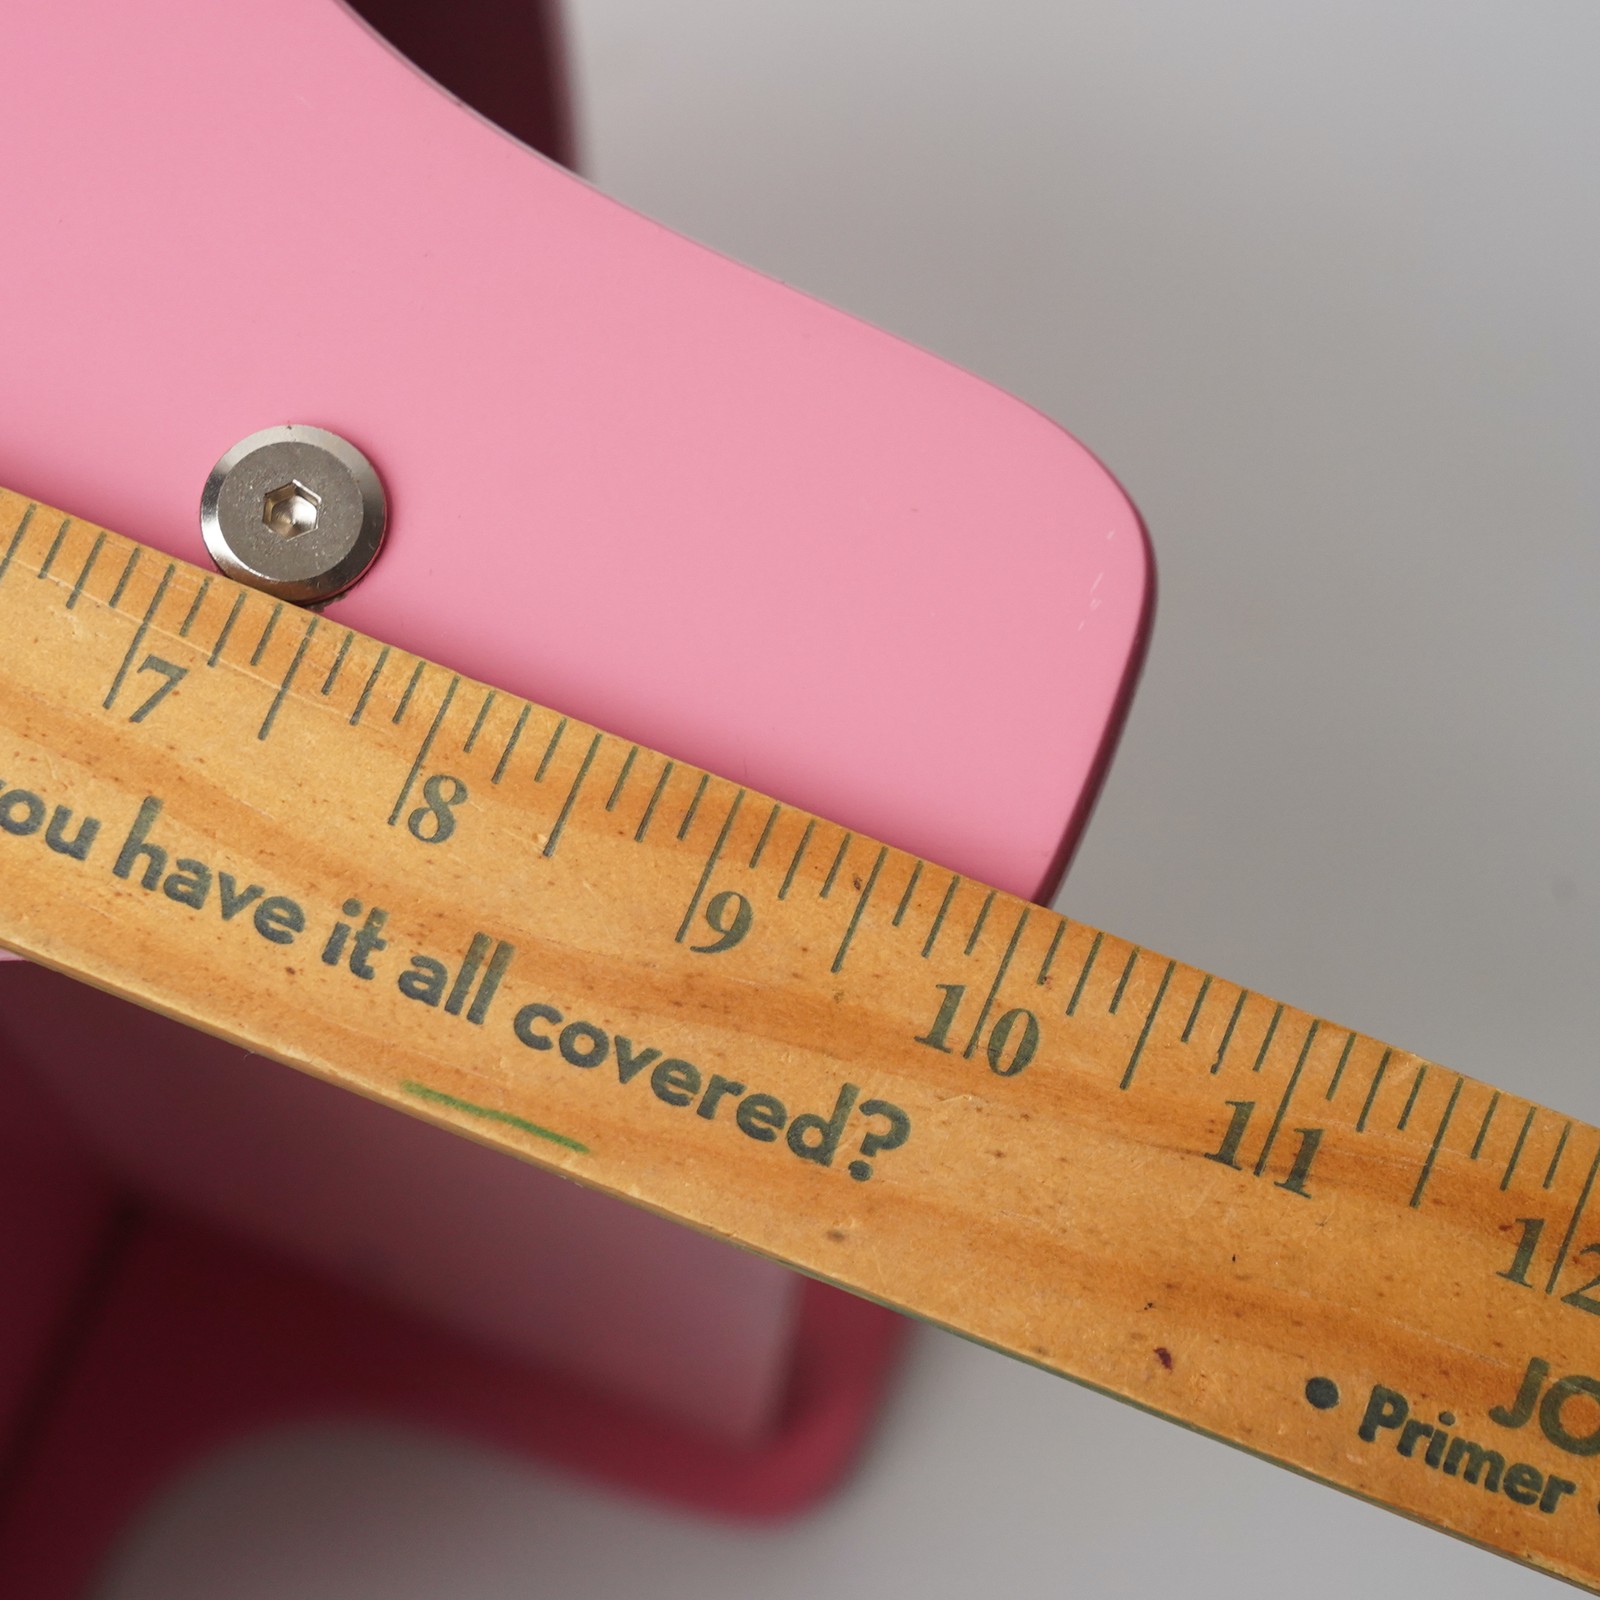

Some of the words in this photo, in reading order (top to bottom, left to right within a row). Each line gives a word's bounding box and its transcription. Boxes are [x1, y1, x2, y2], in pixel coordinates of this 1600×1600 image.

[0, 780, 101, 861] ou
[112, 795, 306, 945] have
[321, 898, 390, 981] it
[398, 931, 516, 1026] all
[513, 1002, 911, 1182] covered?
[129, 654, 190, 723] 7
[407, 774, 469, 844] 8
[690, 891, 754, 954] 9
[914, 984, 1041, 1077] 10
[1204, 1100, 1325, 1199] 11
[1357, 1383, 1577, 1514] Primer
